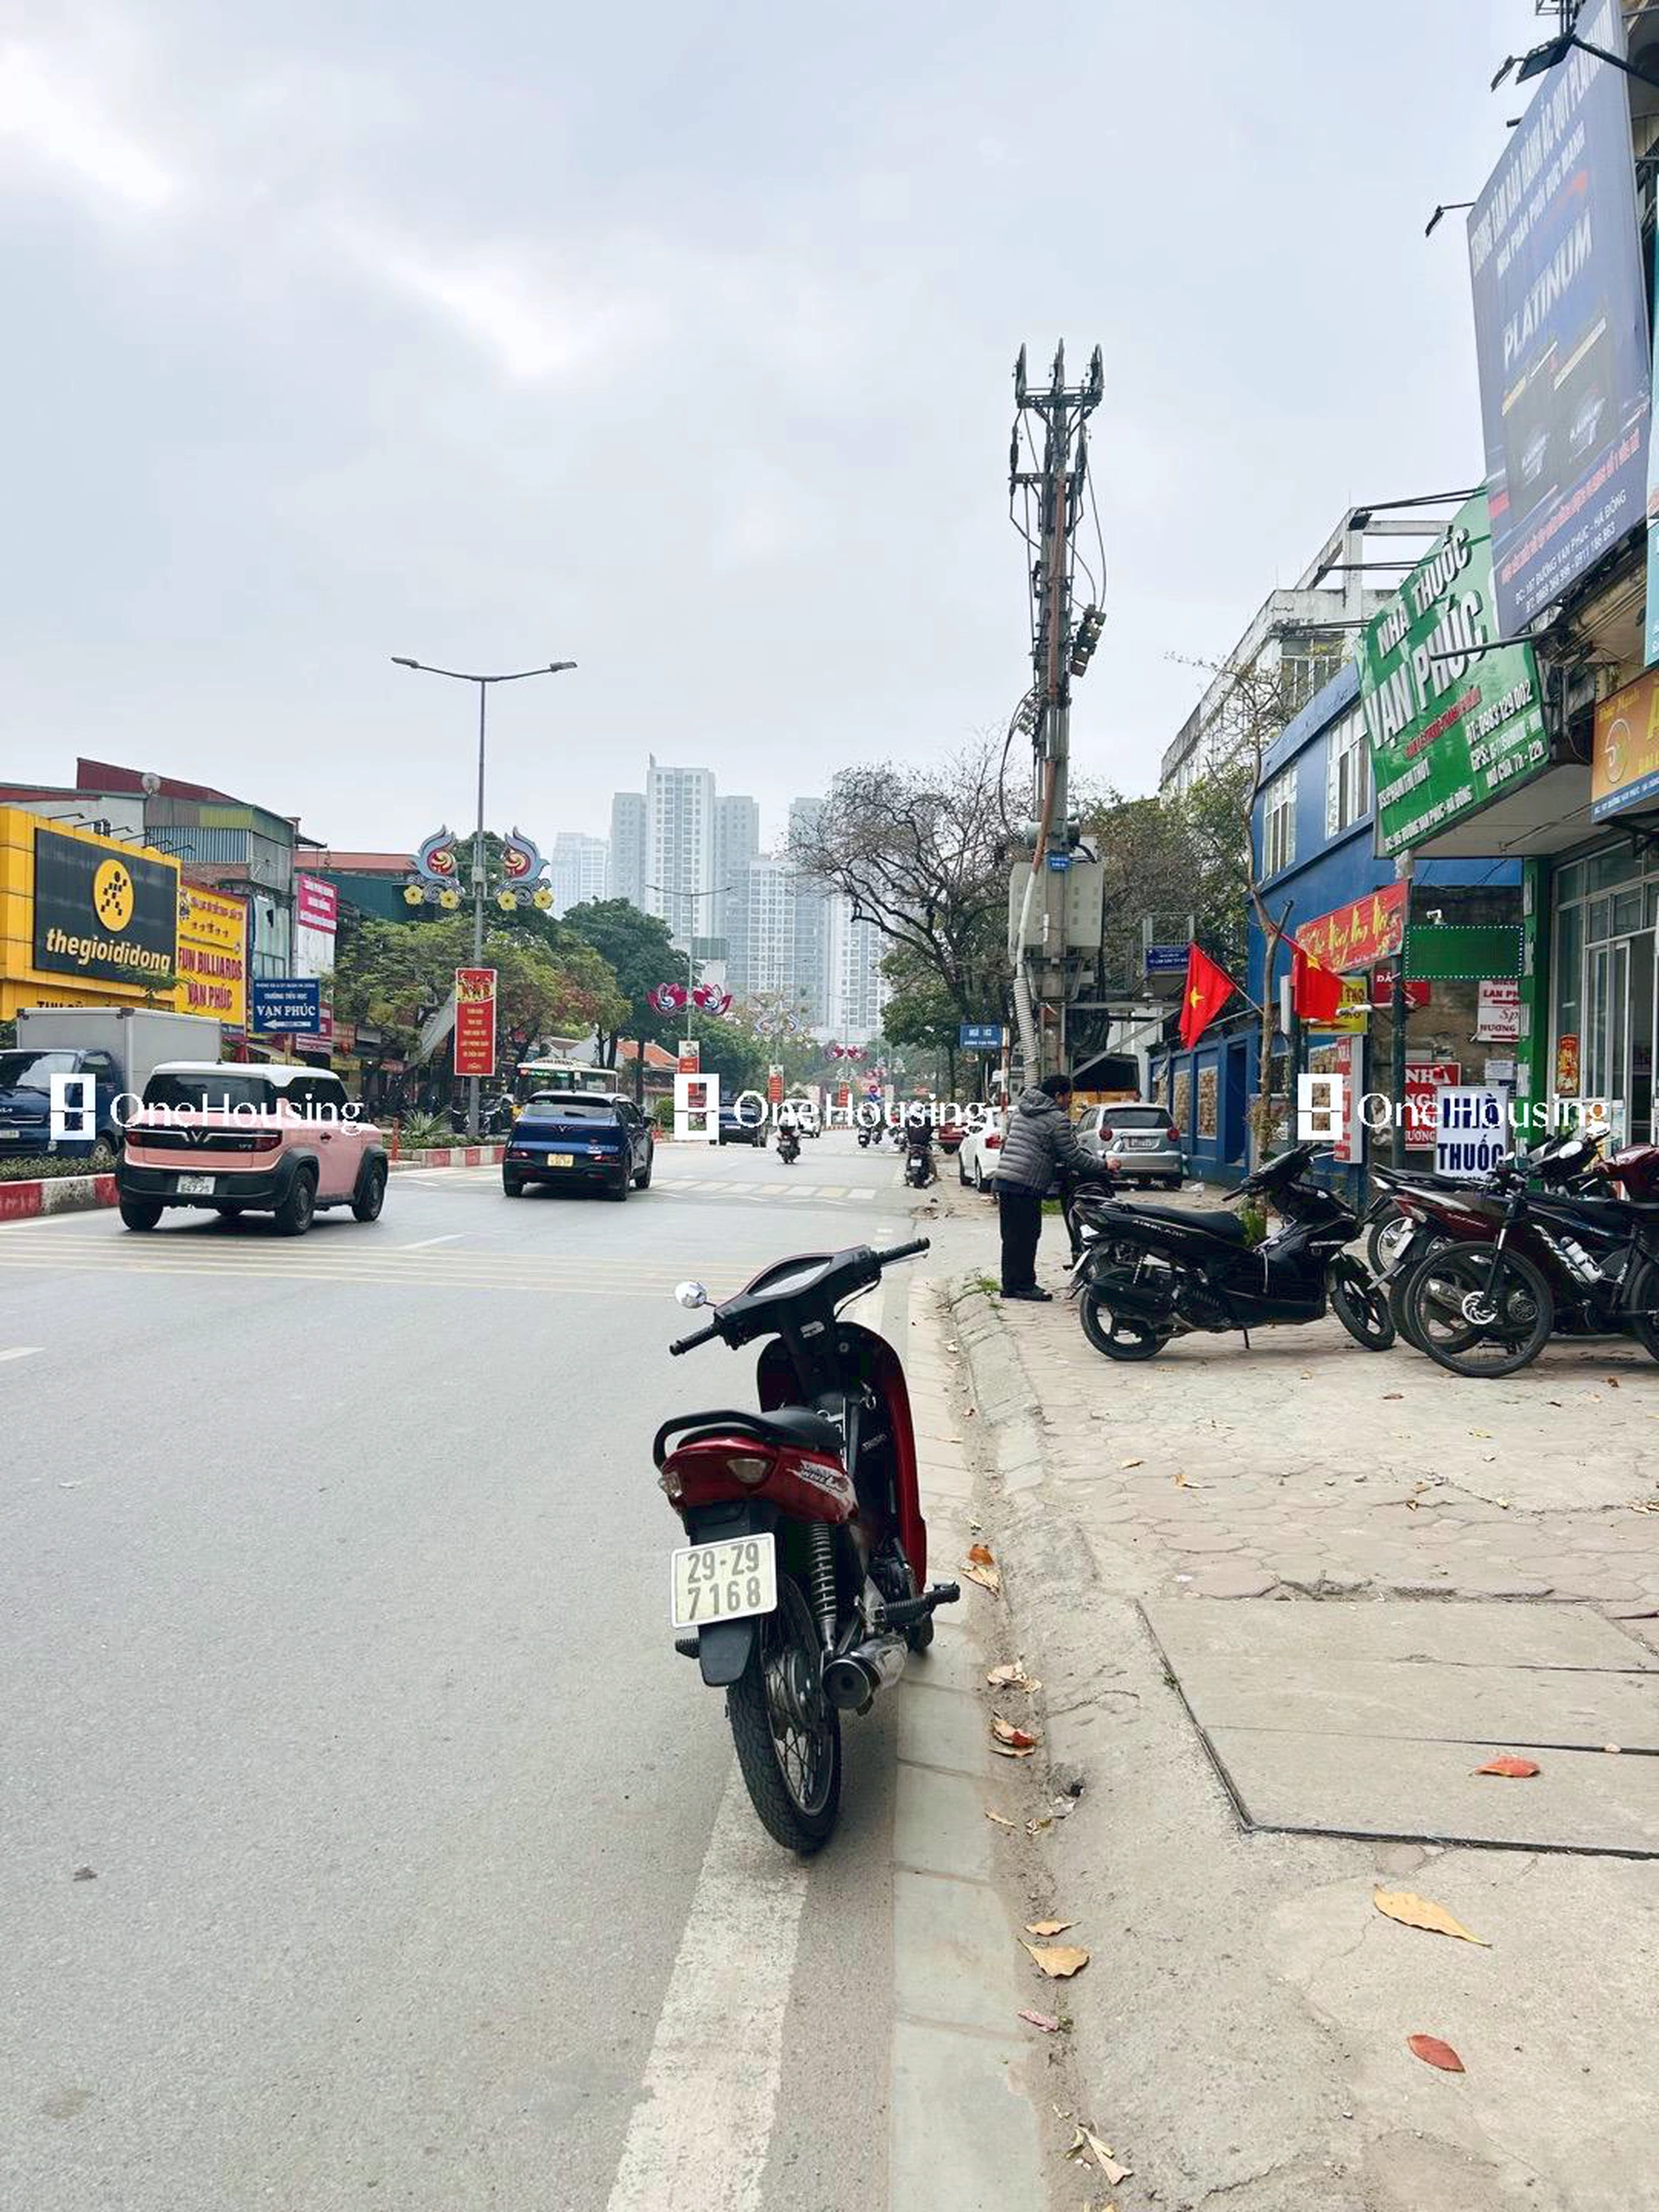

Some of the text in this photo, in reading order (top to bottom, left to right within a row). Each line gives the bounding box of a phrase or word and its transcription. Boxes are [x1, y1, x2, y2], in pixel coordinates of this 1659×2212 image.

[1504, 206, 1592, 371] PLATINUM
[1412, 525, 1472, 619] THUỐC
[1365, 662, 1416, 750] VẠN
[1412, 590, 1487, 710] PHÚC
[46, 928, 172, 971] thegioididong
[196, 950, 243, 981] BILLIARDS
[256, 1003, 316, 1018] VẠN PHÚC
[1443, 1093, 1501, 1129] NHÀ
[1437, 1134, 1504, 1171] THUỐC
[687, 1580, 762, 1621] 7168
